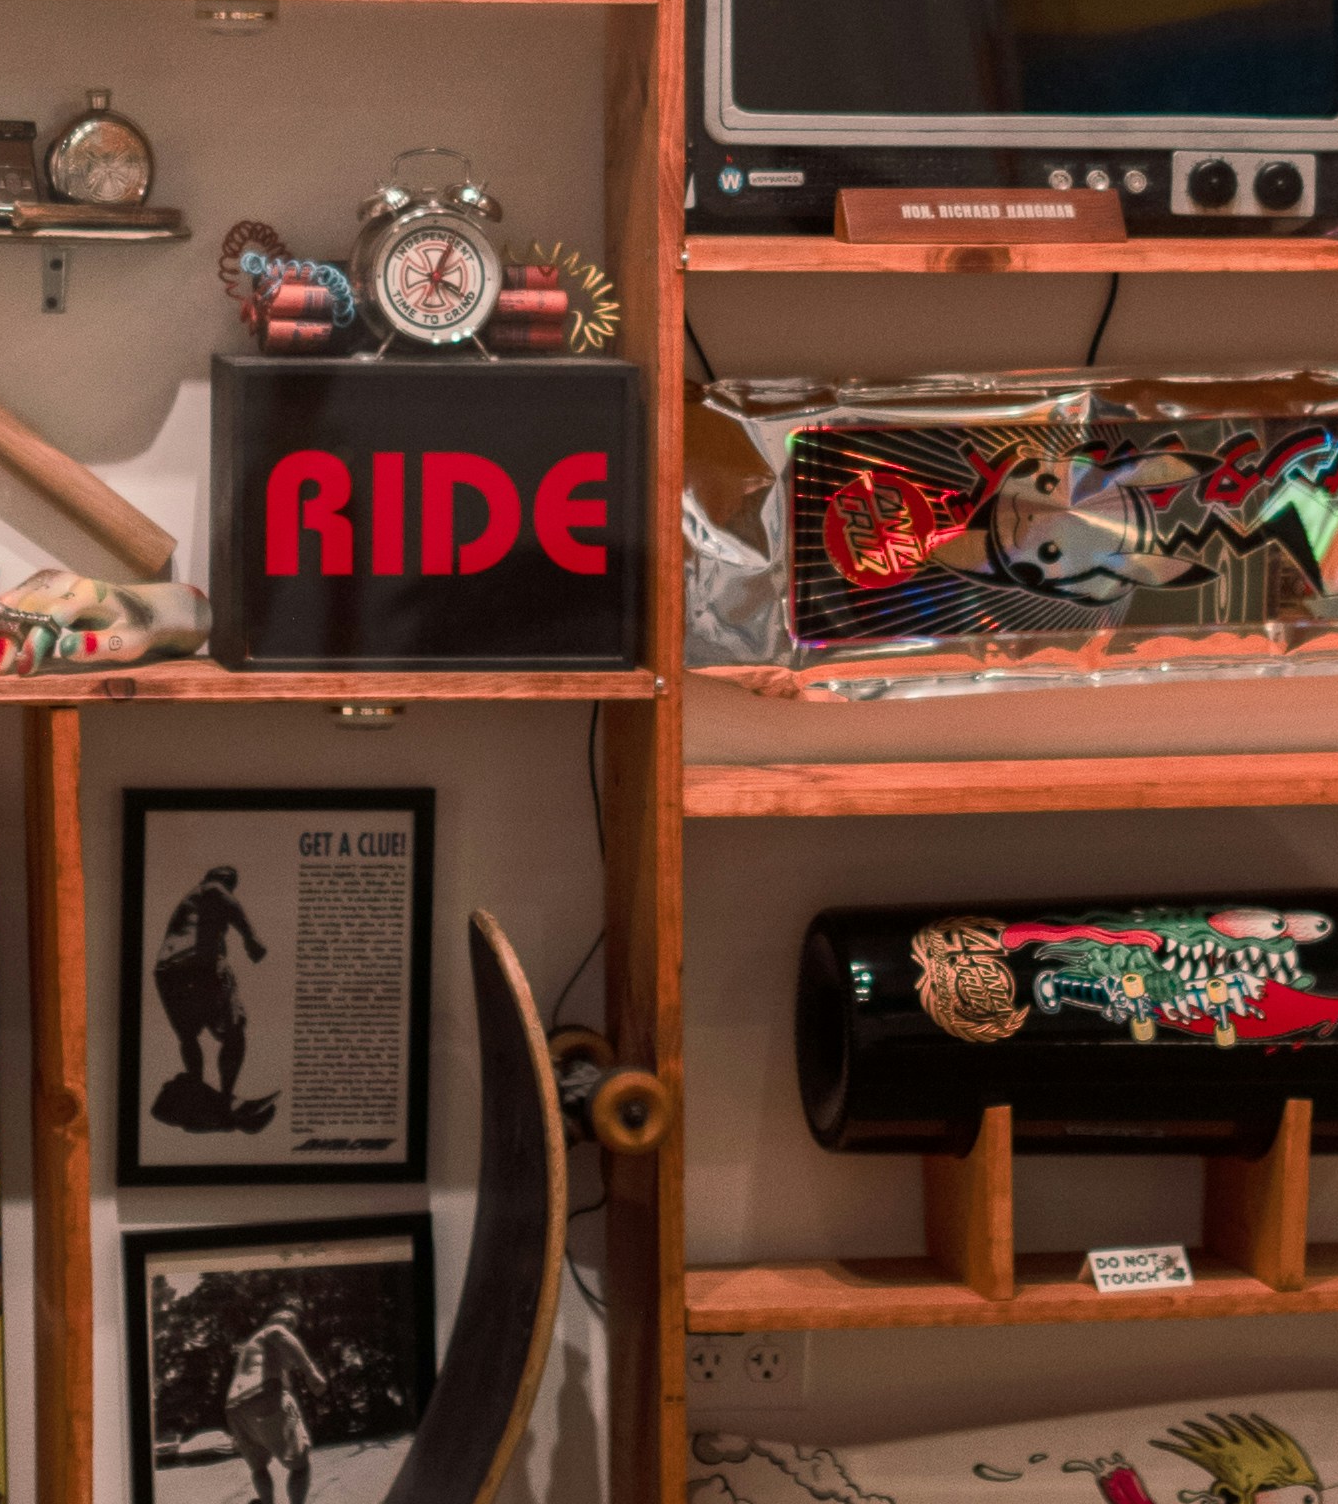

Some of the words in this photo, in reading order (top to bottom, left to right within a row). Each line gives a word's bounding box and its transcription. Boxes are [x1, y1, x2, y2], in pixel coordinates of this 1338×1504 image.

[900, 203, 936, 220] HON.
[938, 203, 1001, 220] RICHARD
[1005, 203, 1076, 220] HANGMAN
[392, 231, 475, 263] INDEPENDENT
[390, 289, 419, 326] TIME
[421, 313, 439, 326] TO
[265, 449, 608, 577] RIDE
[298, 831, 334, 858] GET
[338, 831, 352, 858] A
[357, 831, 407, 858] CLUE!
[1095, 1256, 1120, 1270] DO
[1123, 1253, 1159, 1268] NOT
[1099, 1271, 1159, 1286] TOUCH
